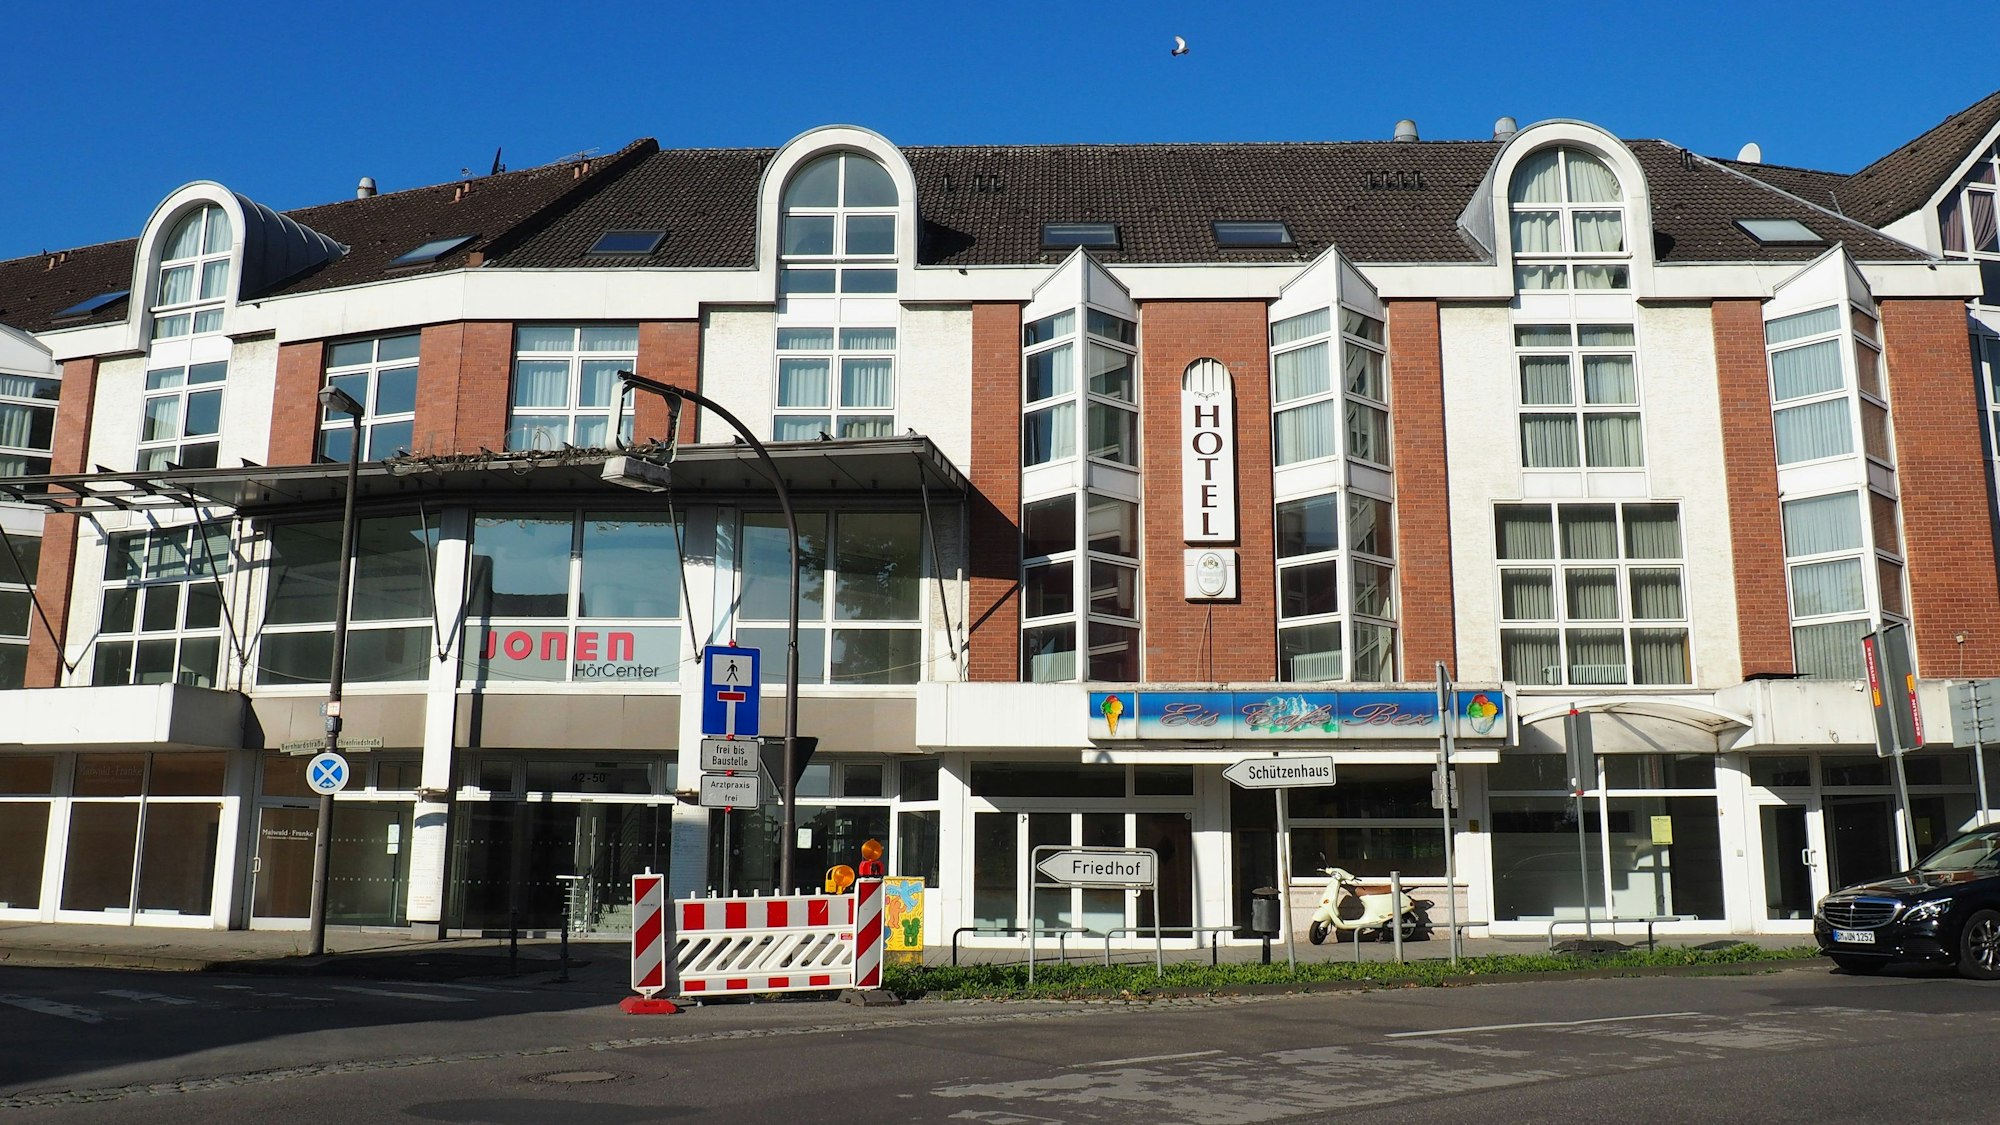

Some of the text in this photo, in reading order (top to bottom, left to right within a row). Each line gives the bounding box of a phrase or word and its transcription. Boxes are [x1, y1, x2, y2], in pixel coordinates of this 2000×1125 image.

[1192, 405, 1223, 536] HOTEL
[575, 663, 660, 678] HörCenter
[1159, 703, 1219, 727] Eis
[716, 745, 745, 754] frei bis
[712, 756, 749, 766] Baustelle
[1248, 765, 1330, 780] Schützenhaus
[710, 781, 750, 789] Arztpraxis
[1073, 860, 1141, 876] Friedhof
[1856, 933, 1873, 941] 1252
